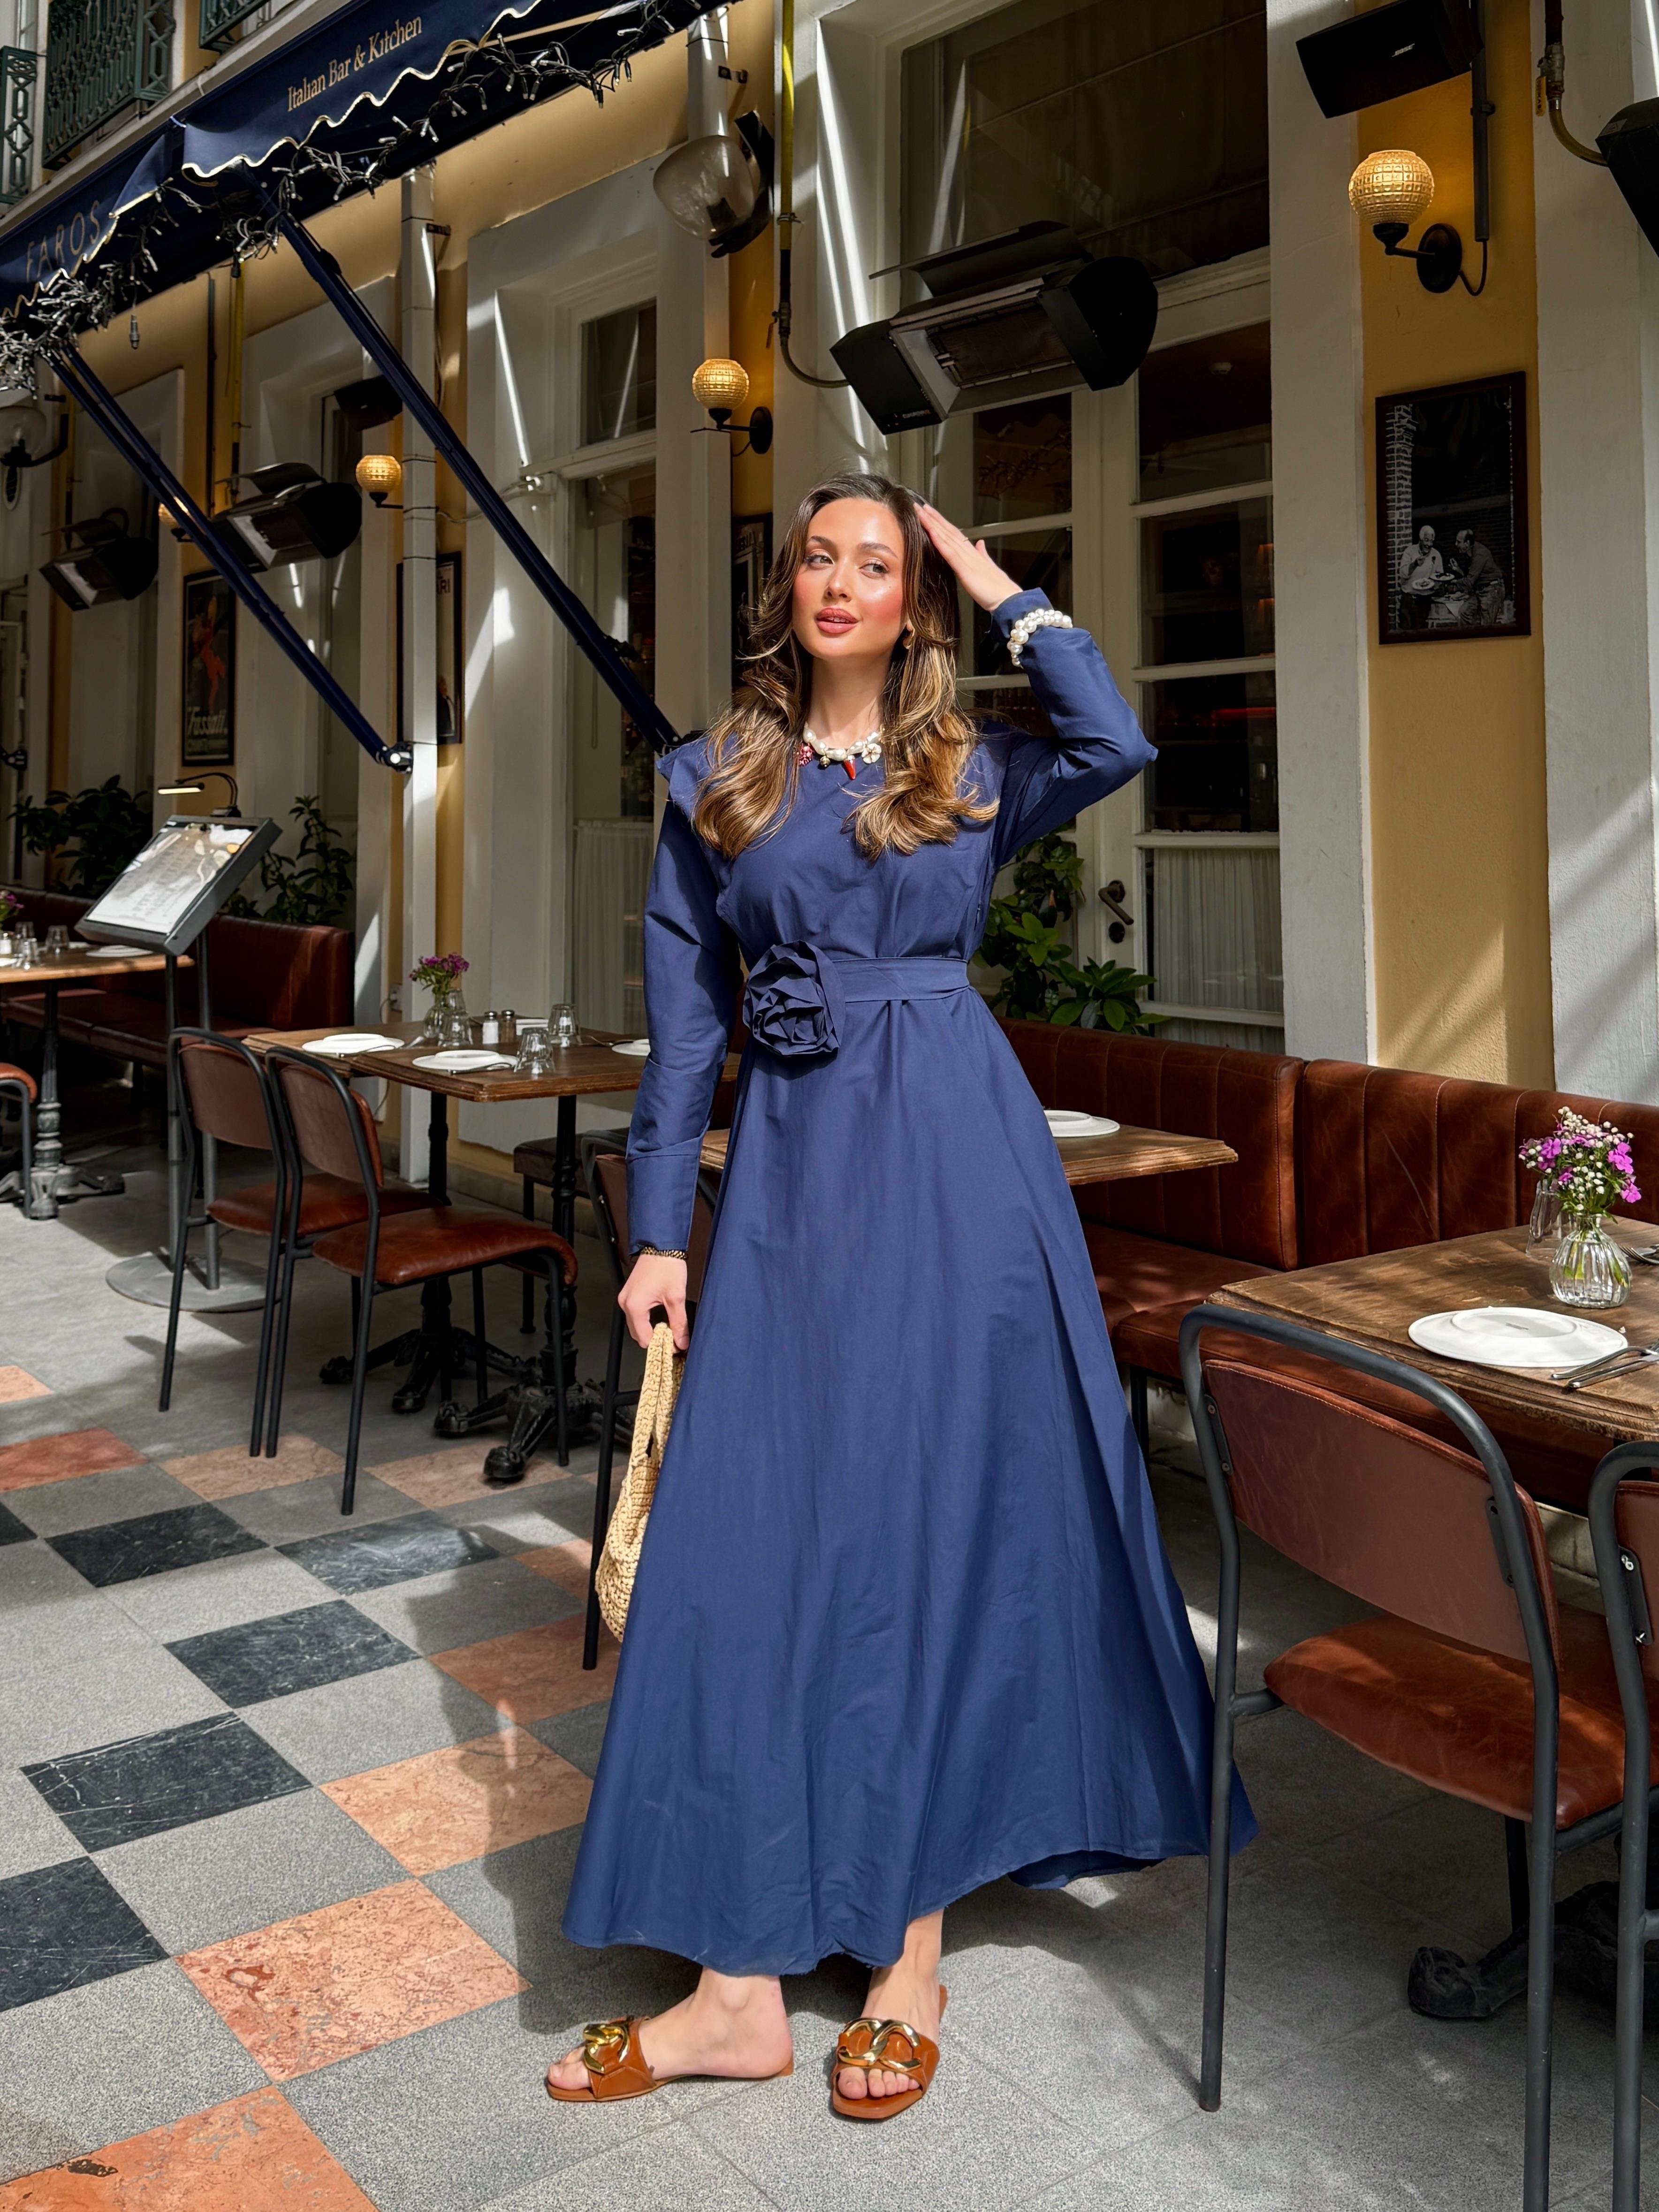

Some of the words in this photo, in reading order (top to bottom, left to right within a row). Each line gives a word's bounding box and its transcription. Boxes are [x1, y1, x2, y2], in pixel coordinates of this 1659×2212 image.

[328, 59, 351, 87] Bar
[354, 44, 365, 71] &
[26, 200, 100, 282] FAROS
